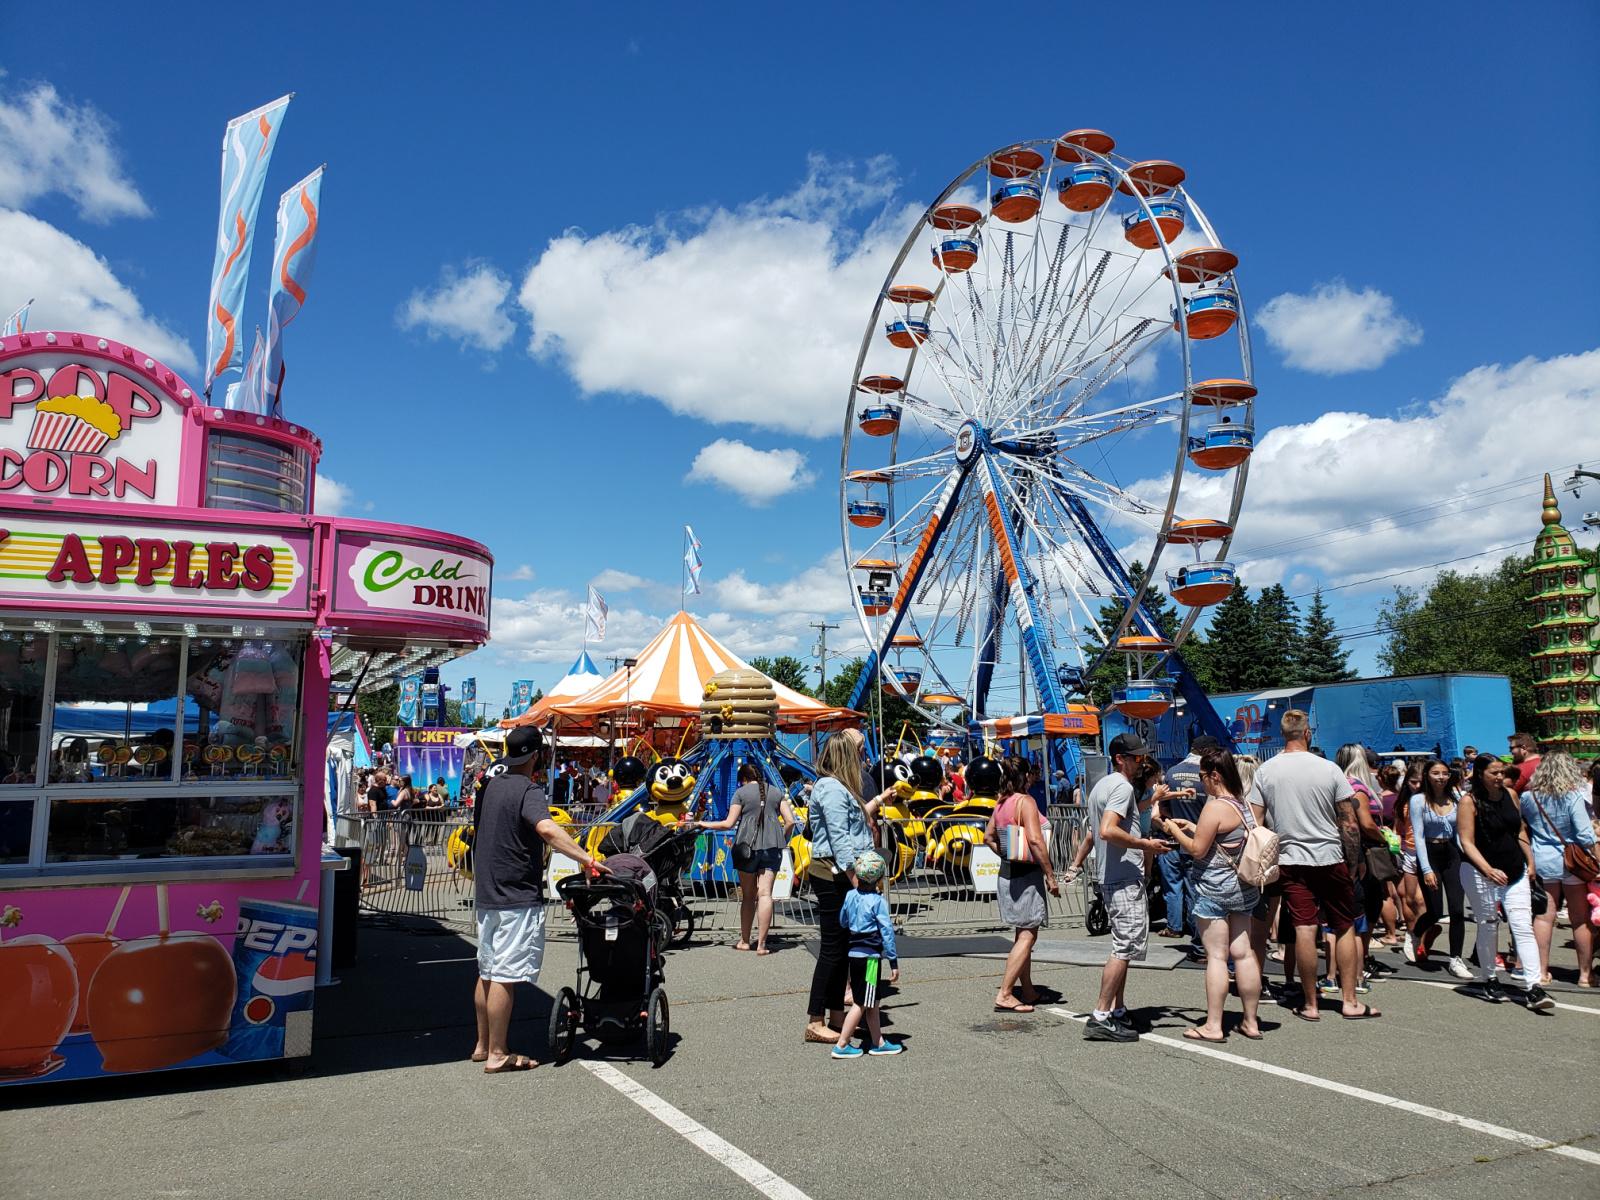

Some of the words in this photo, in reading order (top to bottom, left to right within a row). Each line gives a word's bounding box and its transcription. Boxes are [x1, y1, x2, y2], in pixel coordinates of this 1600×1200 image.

[0, 364, 162, 430] POP
[0, 448, 157, 499] CORN
[46, 533, 275, 591] APPLES
[363, 550, 478, 592] Cold
